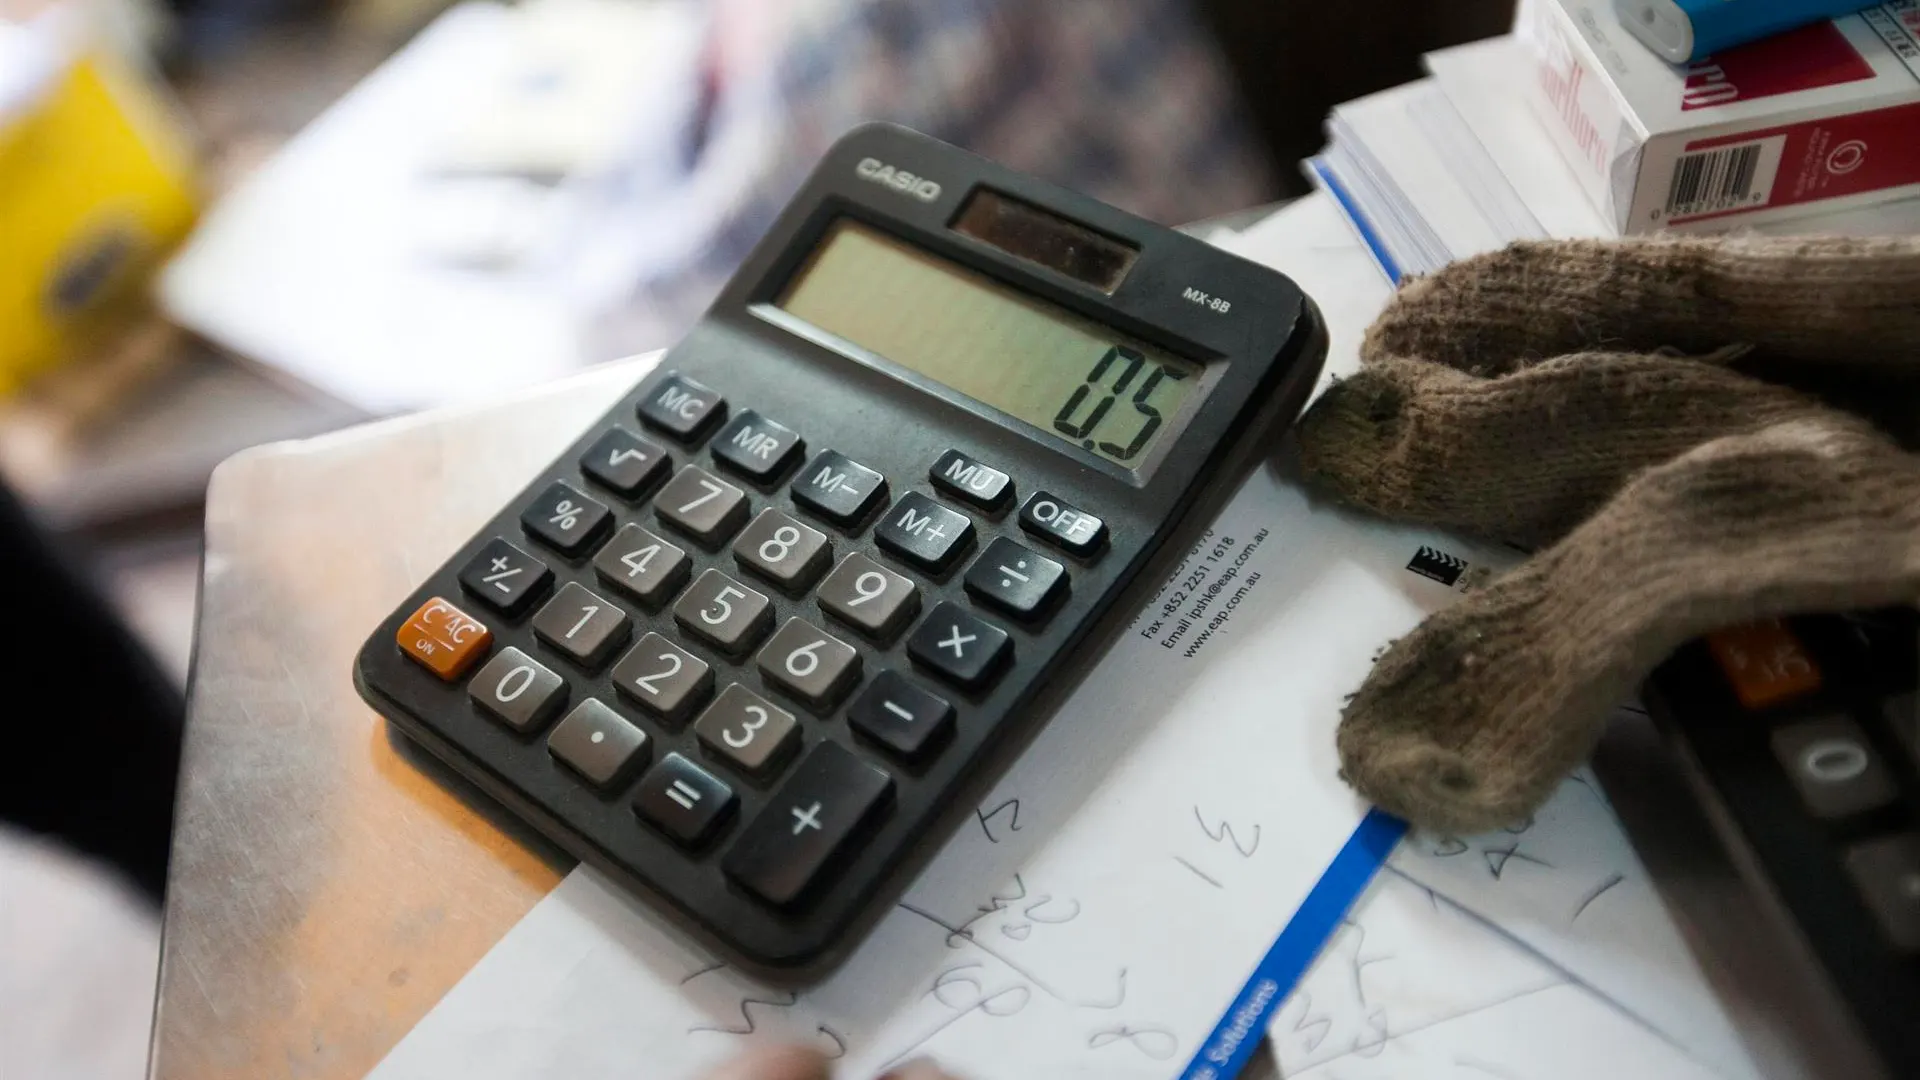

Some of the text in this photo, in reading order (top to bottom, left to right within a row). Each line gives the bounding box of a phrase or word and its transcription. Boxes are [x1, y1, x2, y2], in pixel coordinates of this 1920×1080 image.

[856, 157, 942, 201] CASIO
[1182, 286, 1232, 314] MX-8B
[656, 386, 704, 420] MC
[732, 425, 779, 460] MR
[896, 507, 946, 542] M+
[944, 458, 1094, 536] MU OFF
[678, 479, 722, 513] 7
[759, 525, 800, 562] 8
[847, 571, 887, 607] 9
[620, 544, 661, 577] 4
[700, 585, 746, 625] 5
[785, 639, 827, 677] 6
[1141, 536, 1235, 640] Fax +852 2251 1618
[1160, 618, 1192, 650] Email
[1186, 528, 1270, 620] ipshk@eap.com.au
[1184, 571, 1261, 659] www.eap.com.au
[415, 638, 435, 656] ON
[495, 665, 536, 702] 0
[565, 605, 599, 639] 1
[635, 653, 683, 695] 2
[722, 705, 768, 748] 3
[1806, 741, 1869, 782] 0
[1206, 979, 1278, 1067] Solutions
